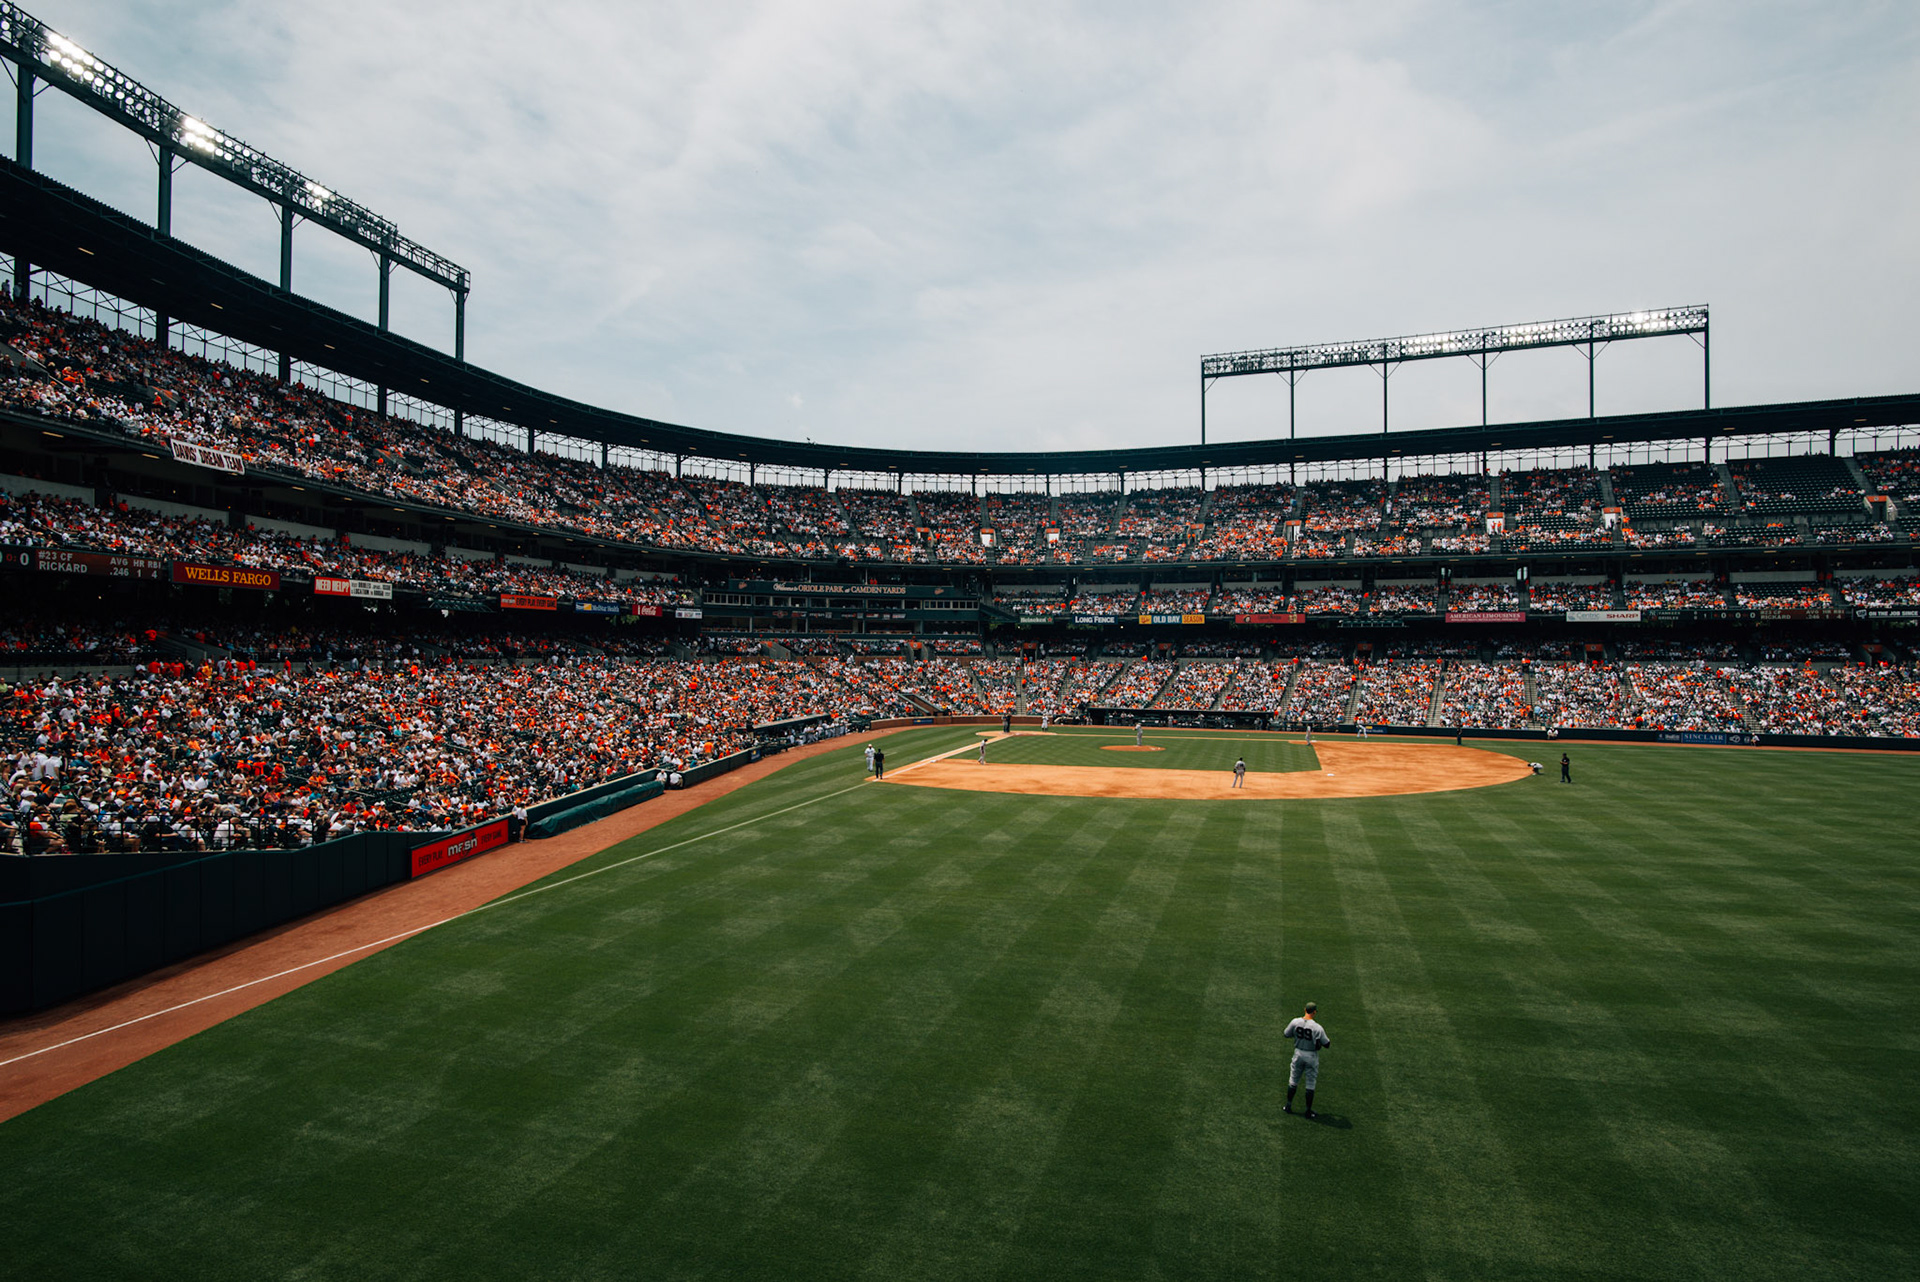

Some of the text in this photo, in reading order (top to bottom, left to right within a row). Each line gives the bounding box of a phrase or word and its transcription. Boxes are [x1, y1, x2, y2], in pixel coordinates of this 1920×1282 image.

[199, 450, 224, 468] DREAM
[224, 455, 243, 472] TEAM
[20, 552, 30, 566] 0
[38, 551, 73, 561] #23 CF
[110, 557, 161, 569] AVG HR RBI
[39, 561, 88, 574] RICKARD
[110, 567, 158, 578] .246 1 4
[185, 567, 271, 586] WELLS FARGO
[316, 579, 331, 591] NEED
[332, 580, 349, 593] HELP?
[1296, 1026, 1312, 1040] 99
